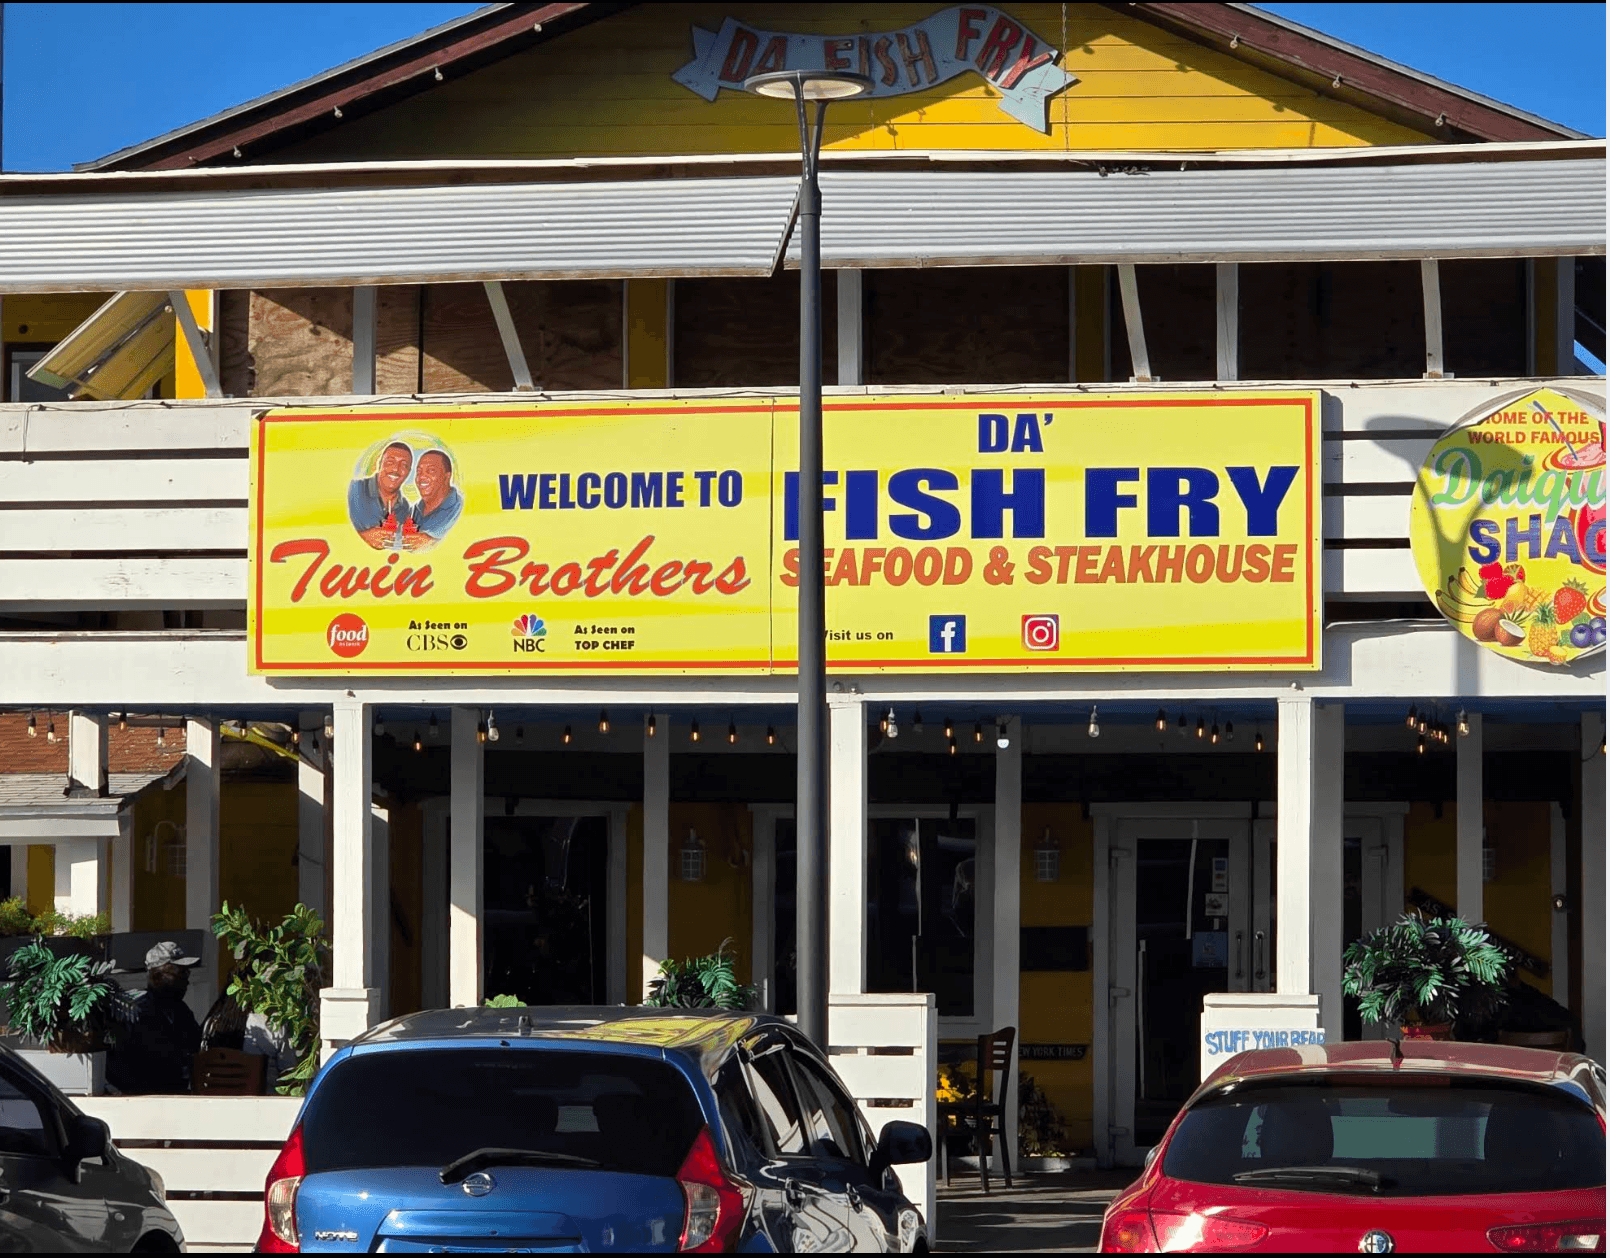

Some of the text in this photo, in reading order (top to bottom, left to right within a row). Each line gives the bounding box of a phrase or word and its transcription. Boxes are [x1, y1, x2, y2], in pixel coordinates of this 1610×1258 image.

[719, 8, 1053, 90] DA FISH FRY
[1532, 411, 1553, 425] OF
[1557, 411, 1590, 424] THE
[1467, 431, 1600, 445] WORLD FAMOUS
[498, 470, 743, 511] WELCOME TO
[783, 465, 1300, 541] FISH FRY
[269, 535, 751, 604] Twin Brothers
[983, 546, 1015, 587] &
[1024, 544, 1298, 584] STEAKHOUSE
[408, 619, 468, 631] As Seen on
[574, 624, 635, 635] As Seen on
[330, 624, 367, 647] food
[406, 634, 449, 651] CBS
[856, 631, 872, 641] us
[877, 631, 894, 640] on
[513, 638, 545, 652] NBC
[575, 640, 635, 651] TOP CHEF
[1205, 1030, 1250, 1055] STUFF
[1252, 1030, 1289, 1050] YOUR
[1018, 1045, 1084, 1058] EW YORK TIMES
